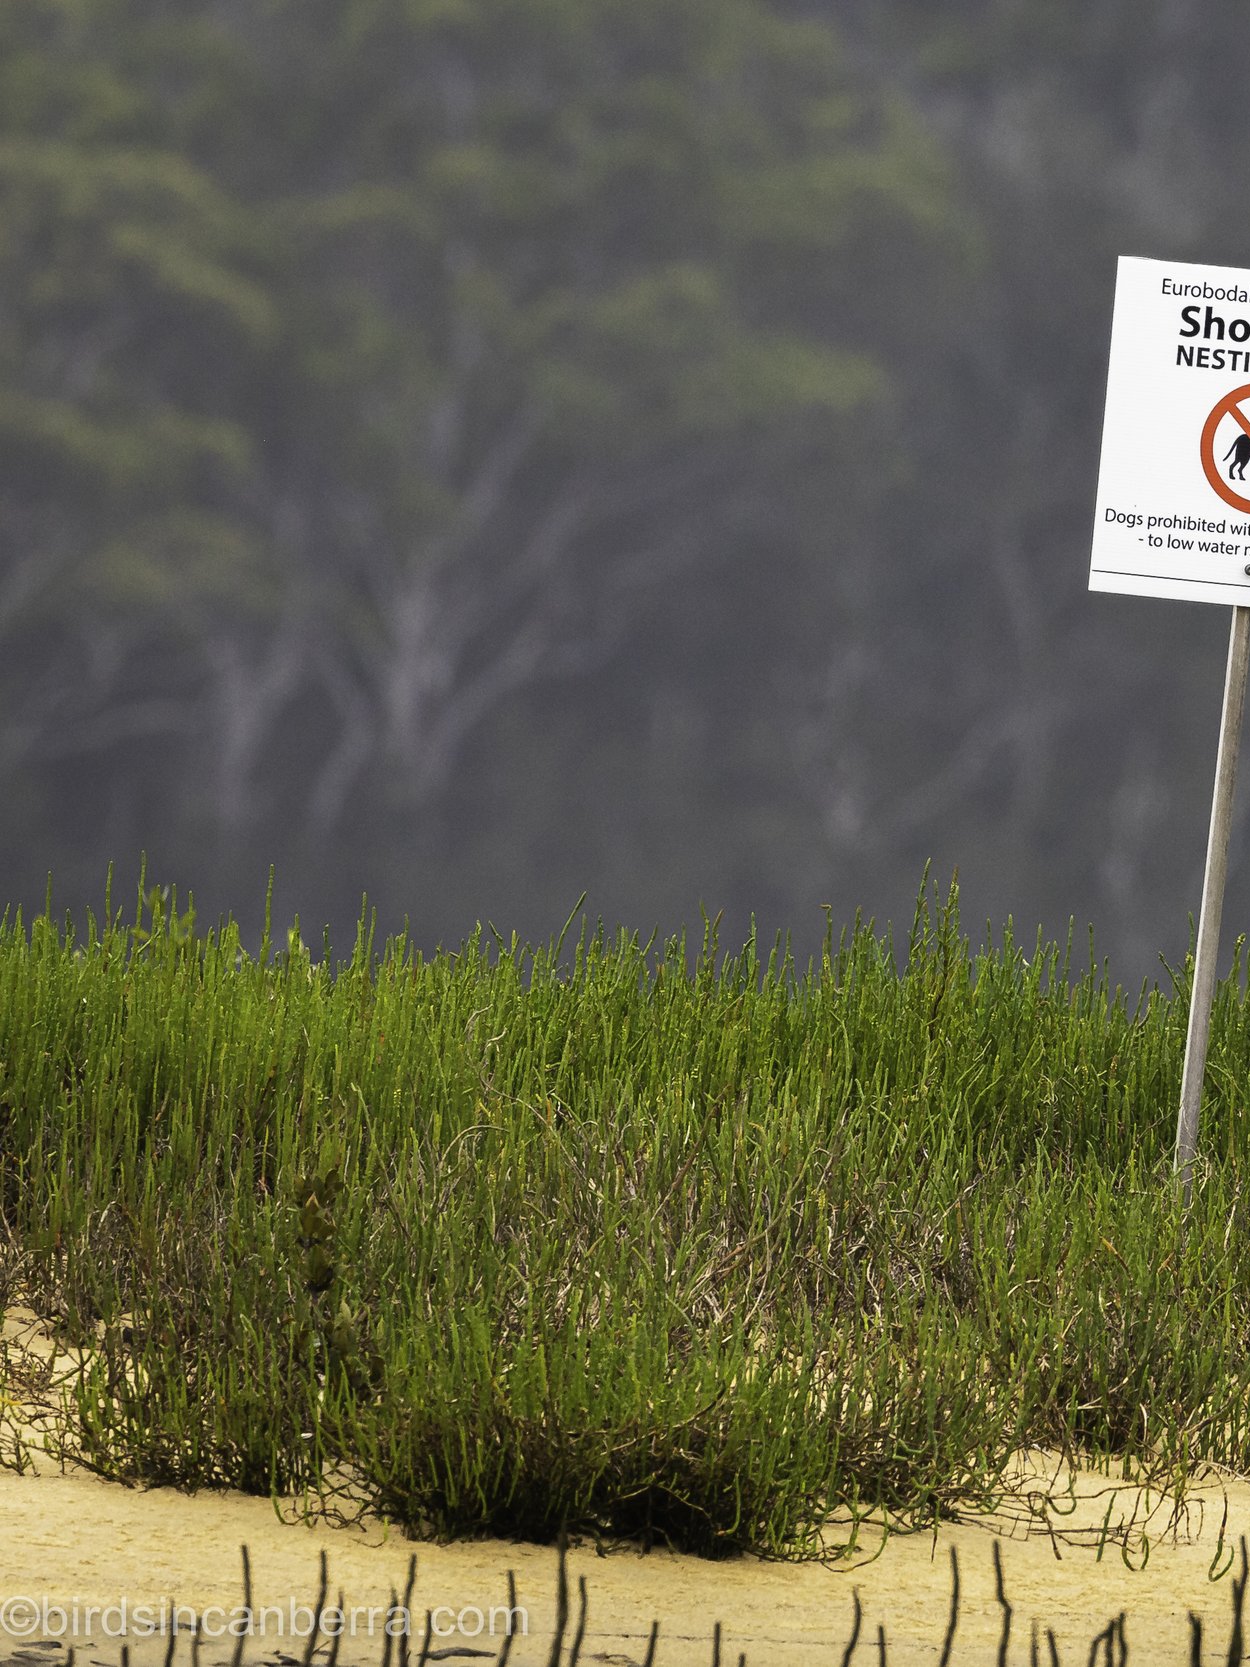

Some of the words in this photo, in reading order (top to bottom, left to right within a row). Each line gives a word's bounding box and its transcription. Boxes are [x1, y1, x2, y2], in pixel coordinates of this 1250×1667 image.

[1105, 508, 1143, 528] Dogs
[1147, 513, 1226, 534] prohibited
[1148, 535, 1163, 548] to
[1167, 534, 1194, 550] low
[1198, 538, 1240, 556] water
